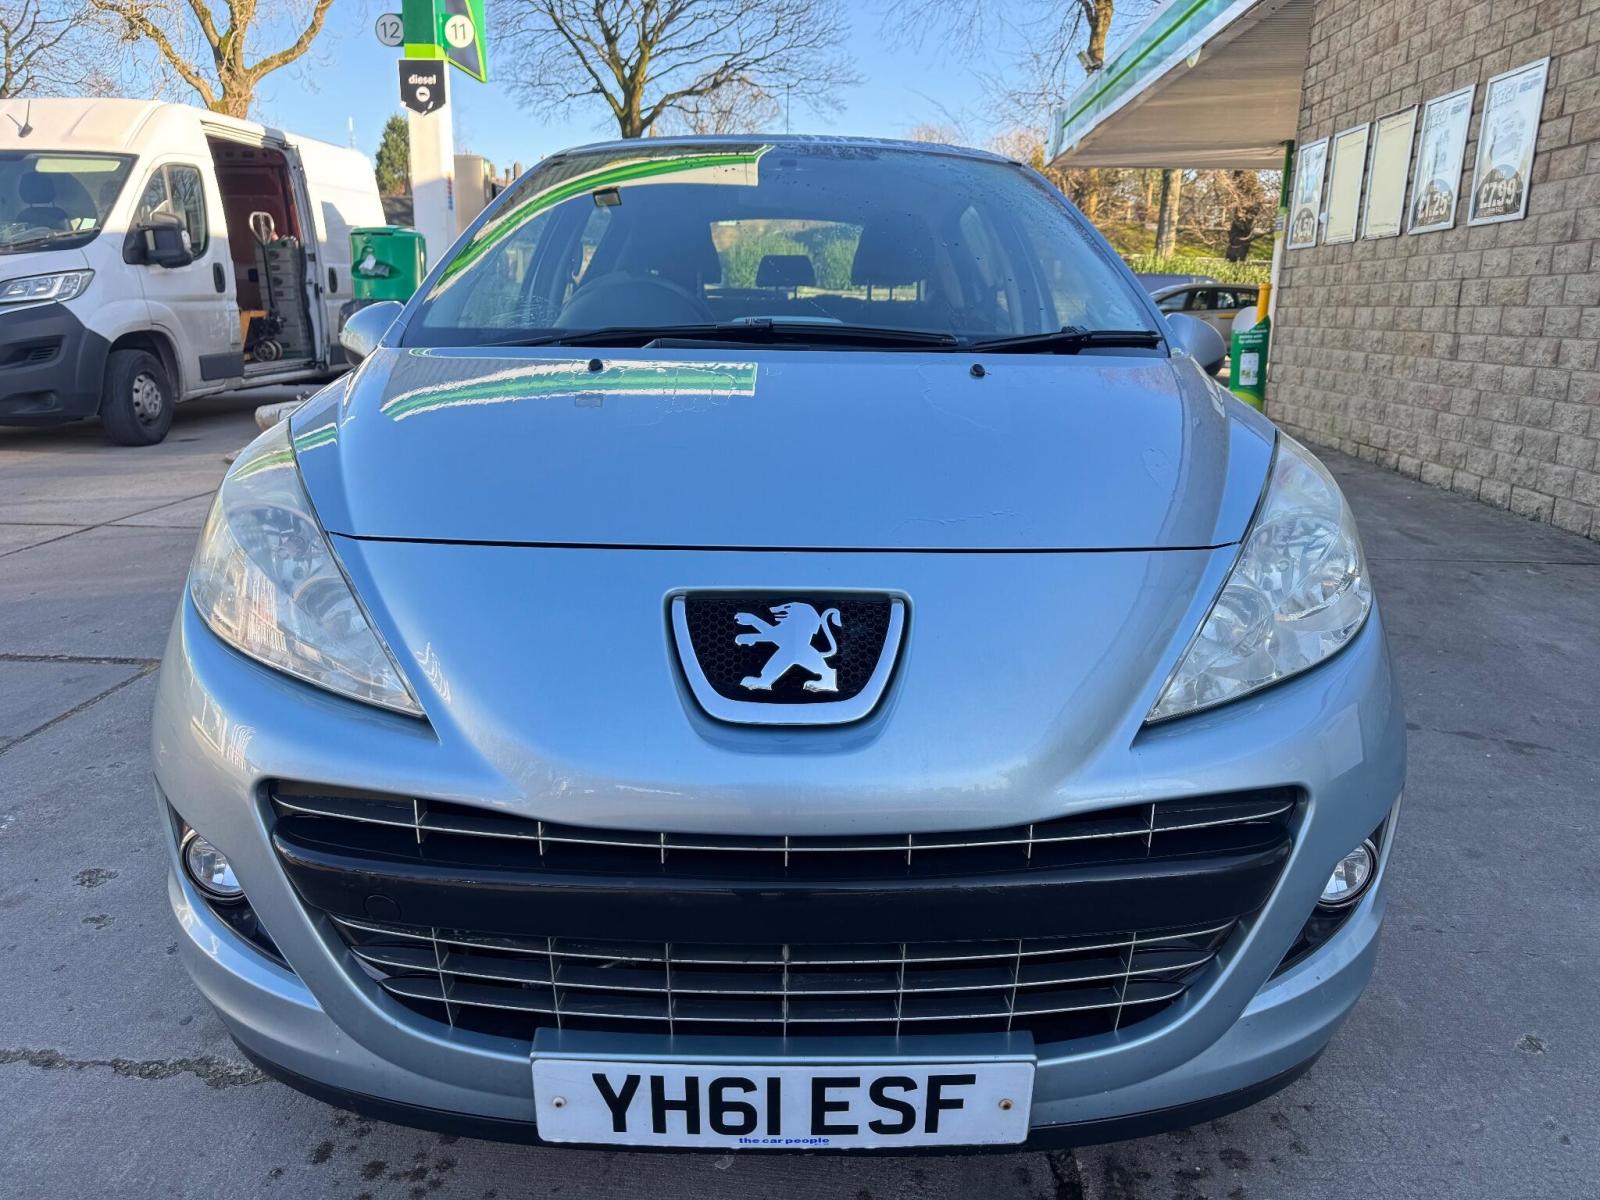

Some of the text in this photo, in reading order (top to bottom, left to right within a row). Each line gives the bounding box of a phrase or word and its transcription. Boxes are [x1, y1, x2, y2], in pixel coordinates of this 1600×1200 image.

[380, 21, 400, 39] 12
[450, 23, 466, 41] 11
[408, 74, 437, 85] diesel
[591, 1072, 977, 1136] YH61 ESF
[785, 1137, 831, 1145] people
